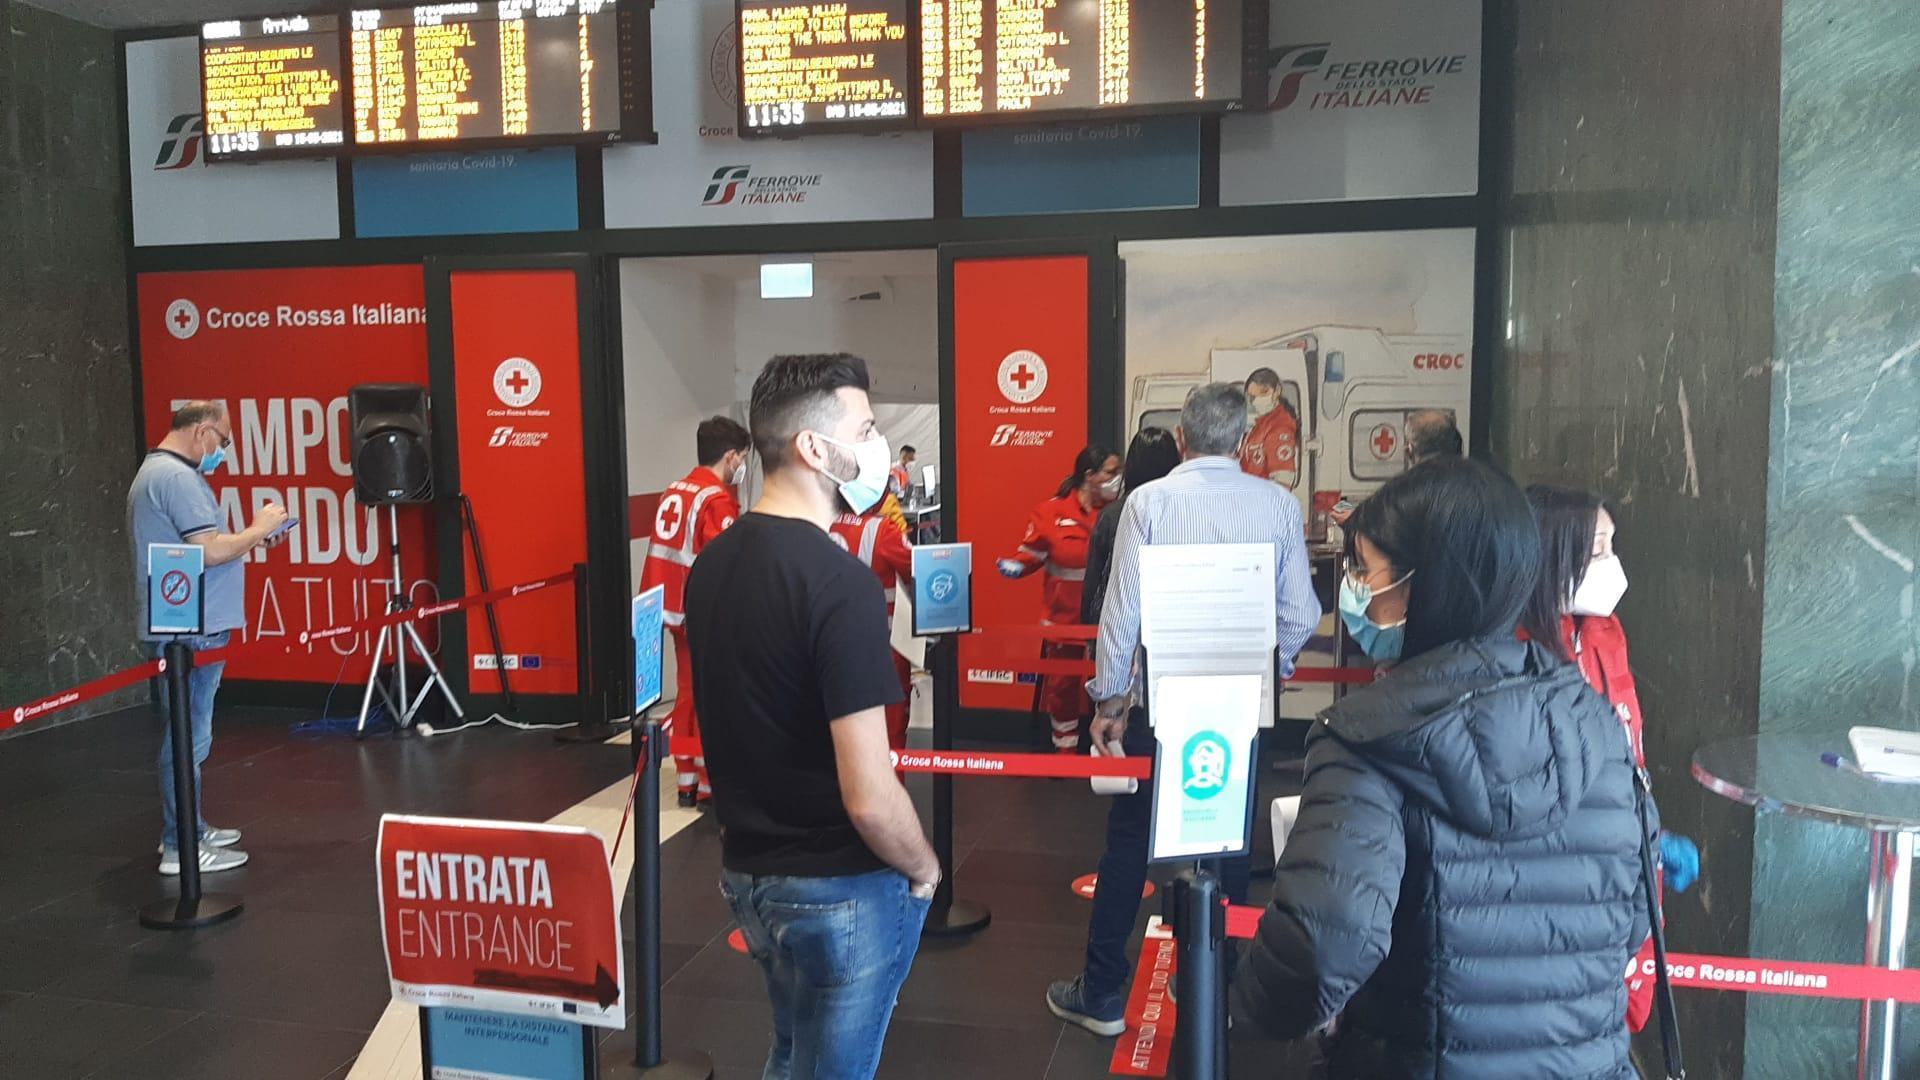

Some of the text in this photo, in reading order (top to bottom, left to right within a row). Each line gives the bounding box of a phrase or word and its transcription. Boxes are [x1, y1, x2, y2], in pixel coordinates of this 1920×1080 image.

[884, 25, 905, 40] YOU
[1323, 55, 1468, 83] FERROVIE
[1309, 86, 1436, 112] ITALIANE
[748, 101, 806, 127] 11:35
[211, 132, 259, 153] 11:35
[699, 126, 735, 139] Croce
[1014, 128, 1074, 145] sanitaria
[409, 159, 460, 173] sanitaria
[748, 174, 823, 188] FERROVIE
[741, 191, 807, 205] ITALIANE
[206, 307, 270, 329] Croce
[276, 305, 346, 327] Rossa
[1412, 353, 1465, 370] CROC
[900, 755, 1004, 770] Croce Rossa Italiana
[395, 849, 553, 909] ENTRATA
[397, 908, 575, 972] ENTRANCE
[1154, 939, 1175, 971] TURNO
[1149, 970, 1169, 991] TUO
[1699, 963, 1757, 984] Rossa
[1760, 968, 1828, 989] Italiana
[1147, 990, 1165, 1002] IL
[1142, 1001, 1163, 1022] QUI
[444, 1010, 505, 1029] MANTENERE
[517, 1020, 570, 1037] DISTANZA
[464, 1026, 550, 1048] INTERPERSONALE
